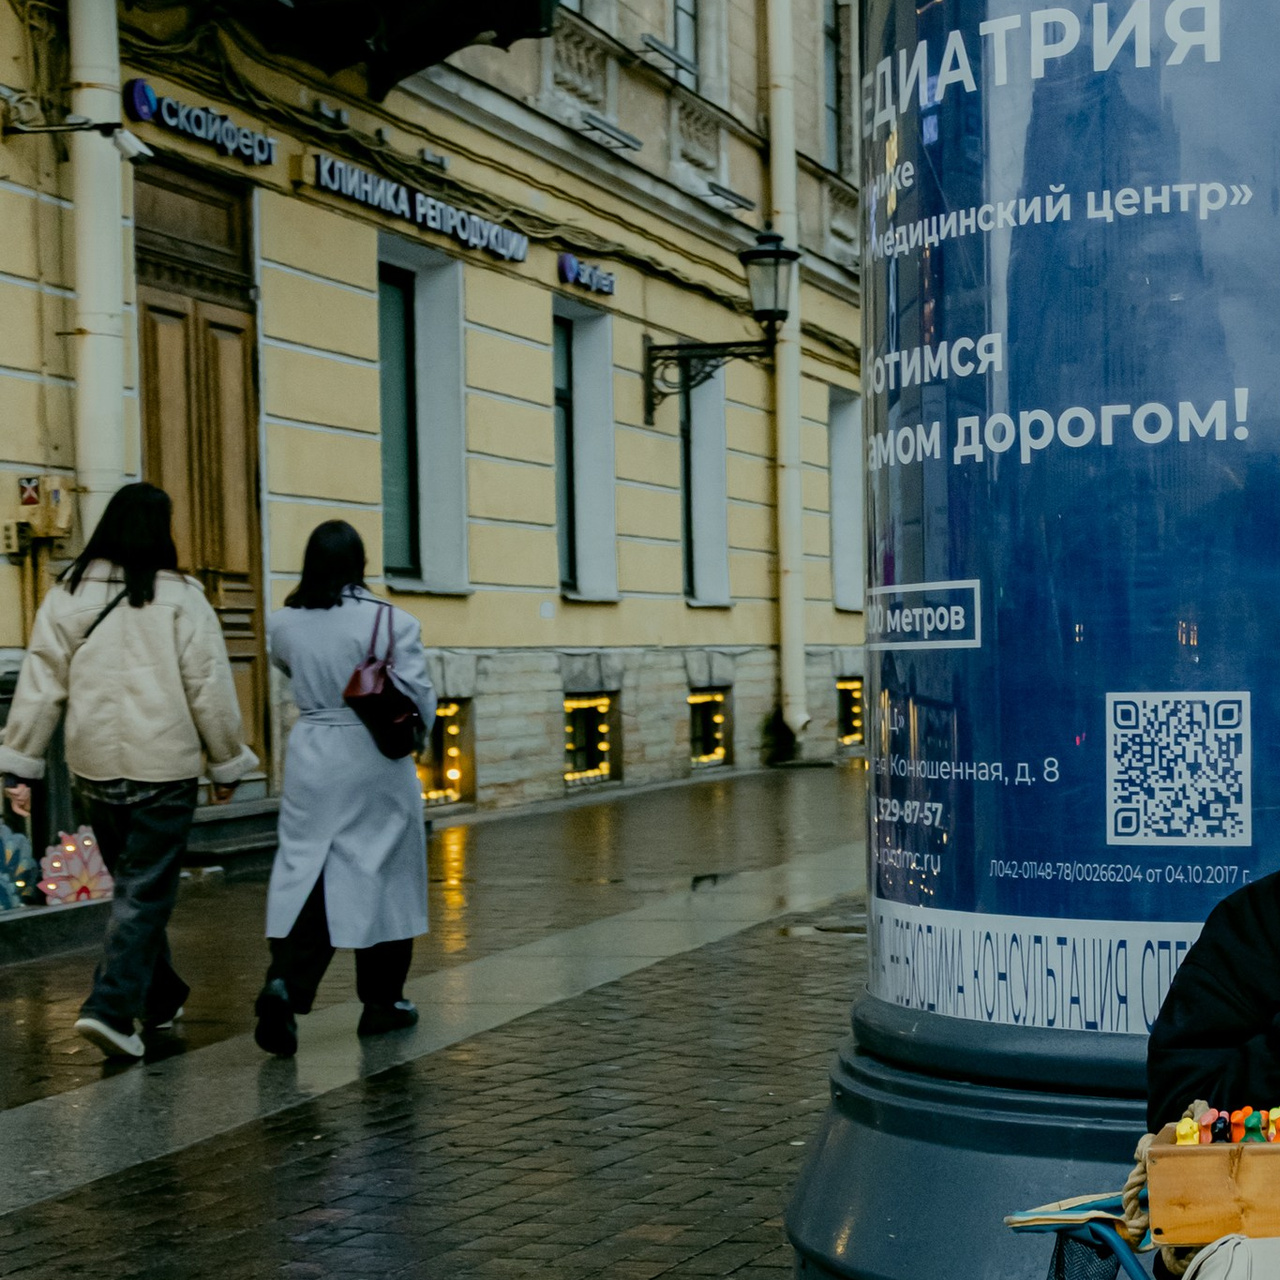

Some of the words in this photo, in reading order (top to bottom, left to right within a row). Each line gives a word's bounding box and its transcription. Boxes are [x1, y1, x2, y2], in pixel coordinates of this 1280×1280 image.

[320, 153, 411, 219] КЛИНИКА
[415, 192, 529, 262] РЕПРОДУКЦИИ
[1086, 180, 1254, 222] центр»
[953, 388, 1250, 465] дорогом!
[886, 605, 966, 640] метров
[890, 753, 1009, 787] Конюшенная,
[1014, 762, 1036, 786] д.
[1043, 757, 1060, 783] 8
[1146, 869, 1162, 884] от
[1165, 865, 1239, 884] 04.10.2017
[973, 929, 1129, 1033] КОНСУЛЬТАЦИЯ
